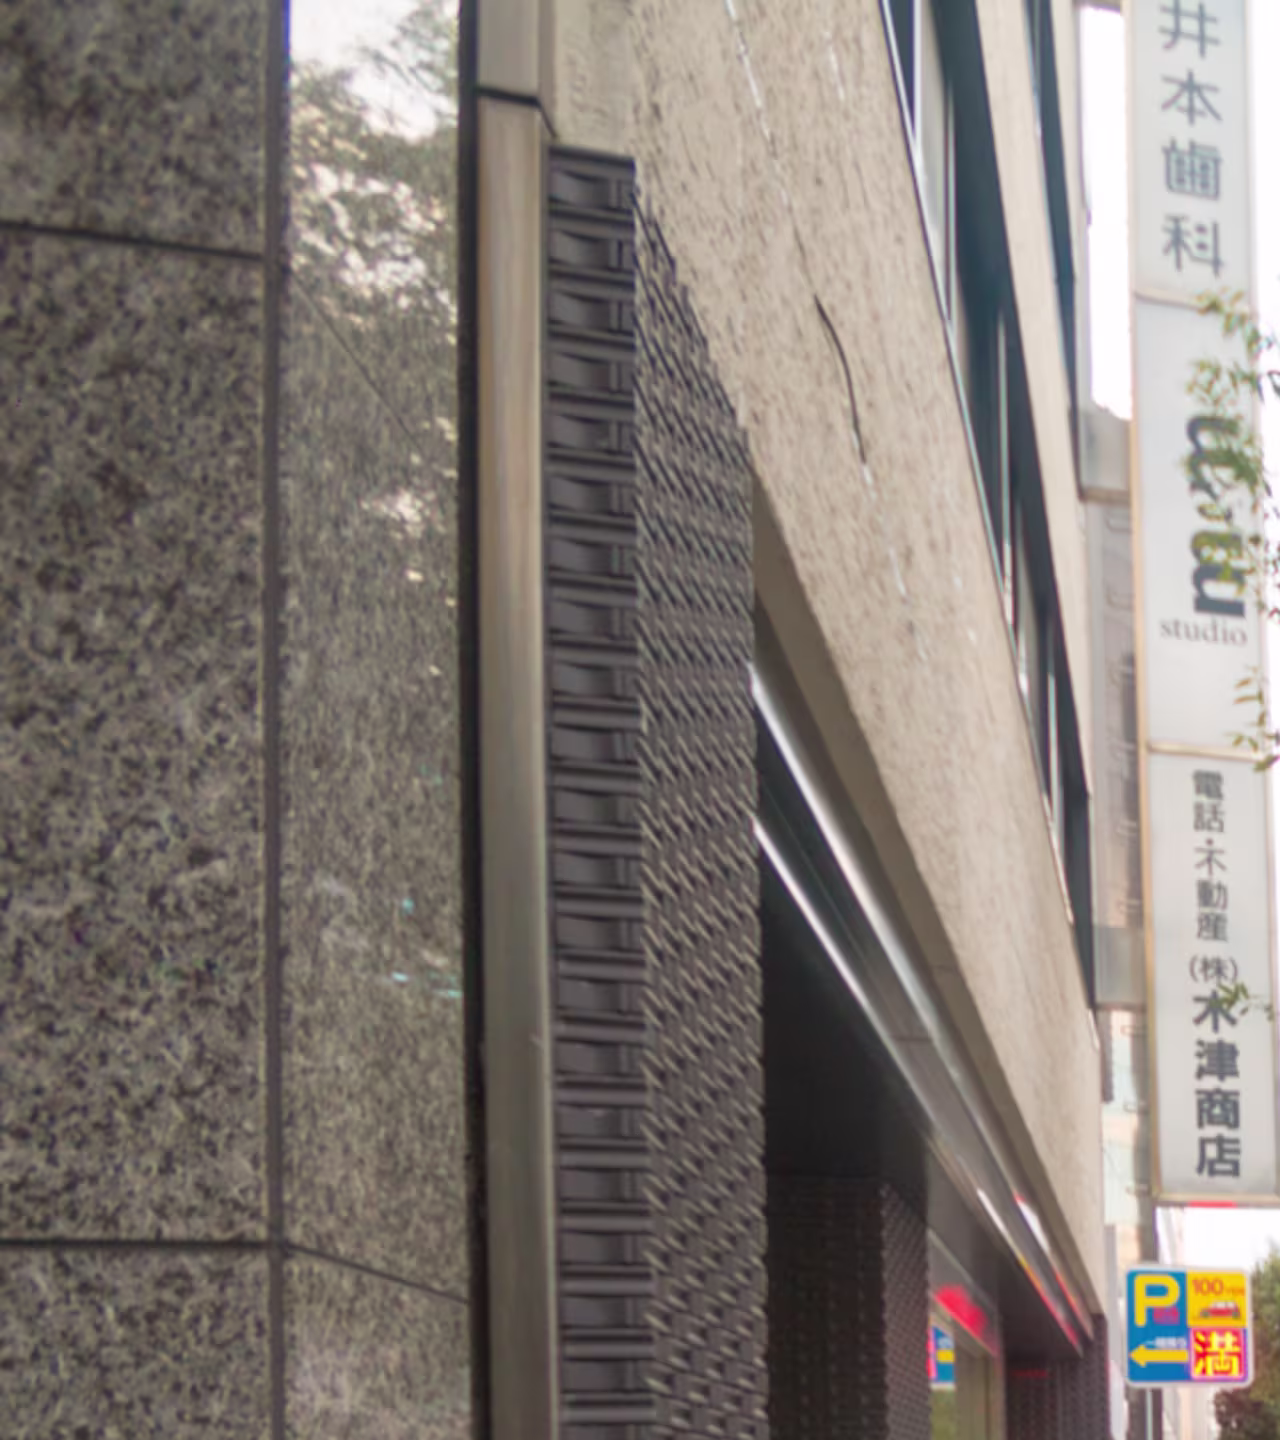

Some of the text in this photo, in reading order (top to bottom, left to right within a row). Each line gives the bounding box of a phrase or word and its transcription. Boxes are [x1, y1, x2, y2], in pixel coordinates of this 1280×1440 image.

[1160, 617, 1248, 648] studio
[1134, 1274, 1180, 1327] P
[1191, 1278, 1224, 1297] 100
[1194, 1330, 1241, 1377] 満
